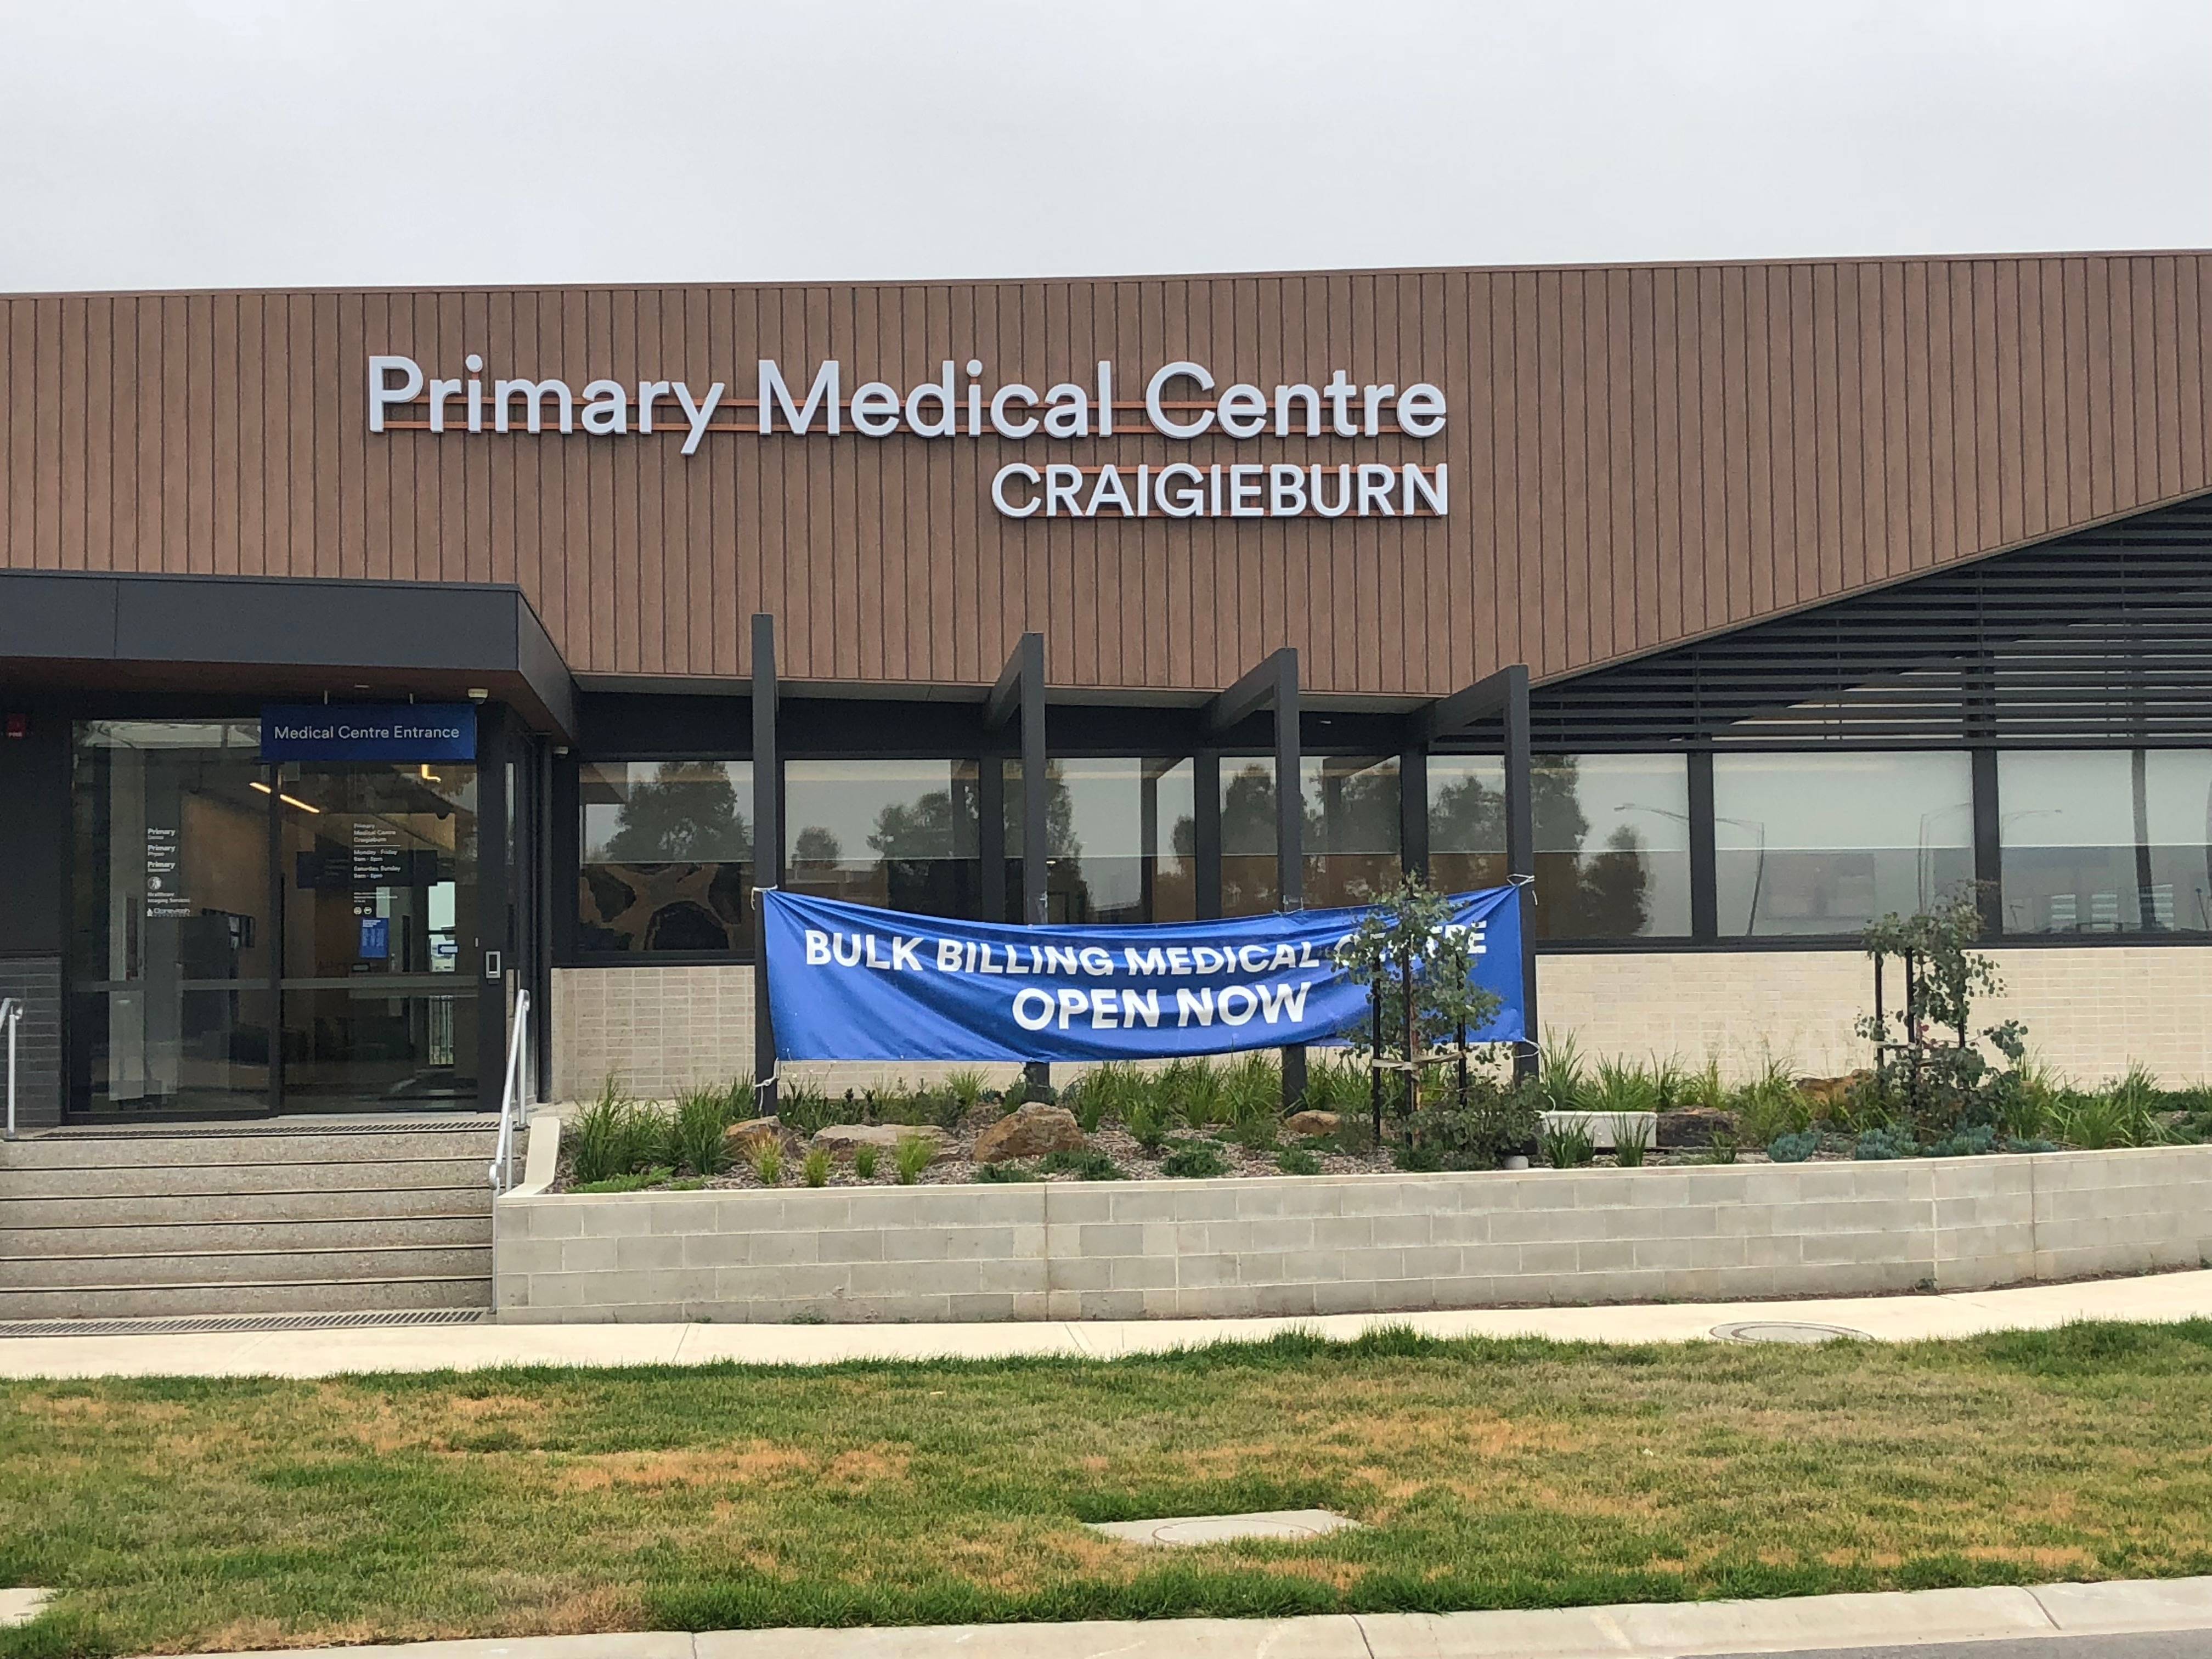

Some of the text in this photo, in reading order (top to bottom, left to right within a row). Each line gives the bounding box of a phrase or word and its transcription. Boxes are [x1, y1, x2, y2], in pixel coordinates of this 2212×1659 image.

[368, 354, 1447, 455] Primary Medical Centre
[991, 462, 1449, 518] CRAIGIEBURN
[274, 725, 460, 740] Medical Centre Entrance
[148, 828, 176, 837] Primary
[148, 861, 176, 869] Primary
[805, 929, 924, 971] BULK
[936, 938, 1115, 976] BILLING
[1124, 941, 1320, 976] MEDICAL
[1012, 981, 1312, 1031] OPEN NOW
